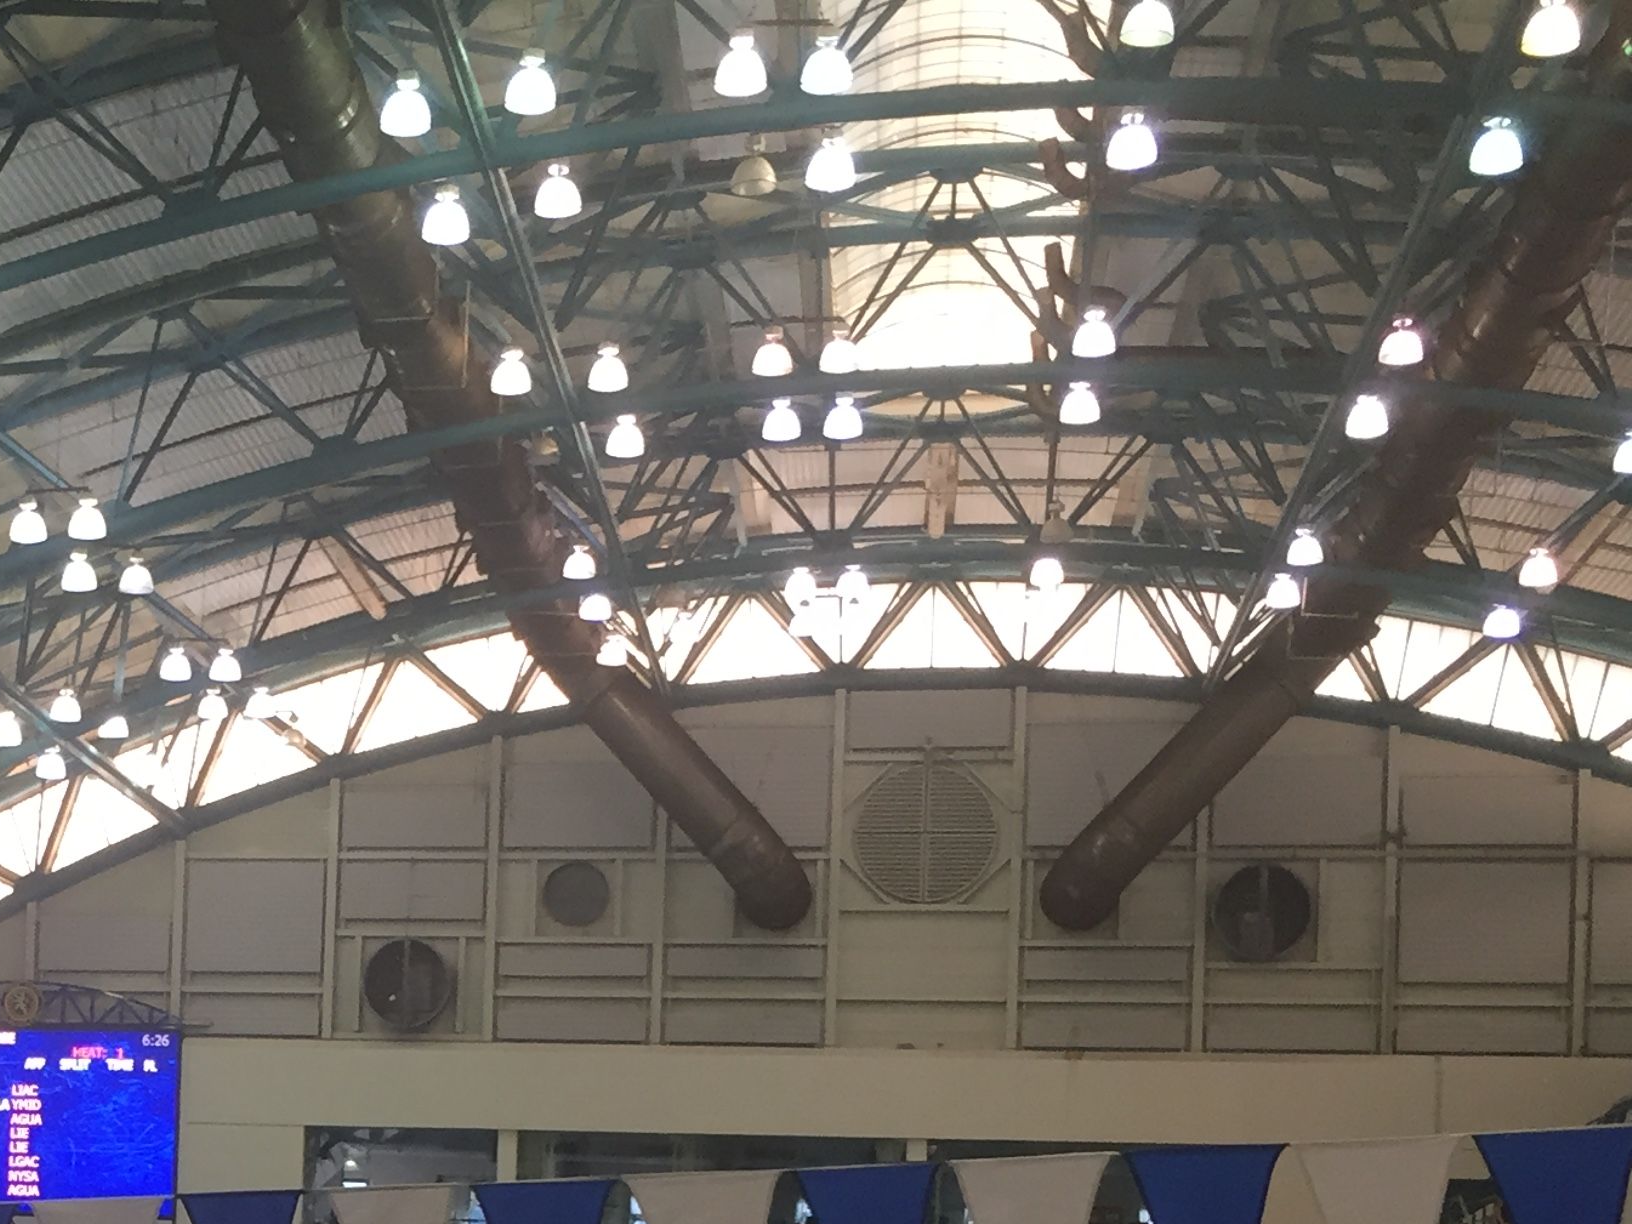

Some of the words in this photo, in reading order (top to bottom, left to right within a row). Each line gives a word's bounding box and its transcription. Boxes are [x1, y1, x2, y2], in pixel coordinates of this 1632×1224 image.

[142, 1034, 169, 1046] 6:26
[73, 1047, 108, 1058] HEAT:
[10, 1113, 43, 1126] AGUA
[7, 1170, 39, 1182] NYSA
[7, 1184, 40, 1197] AGUA
